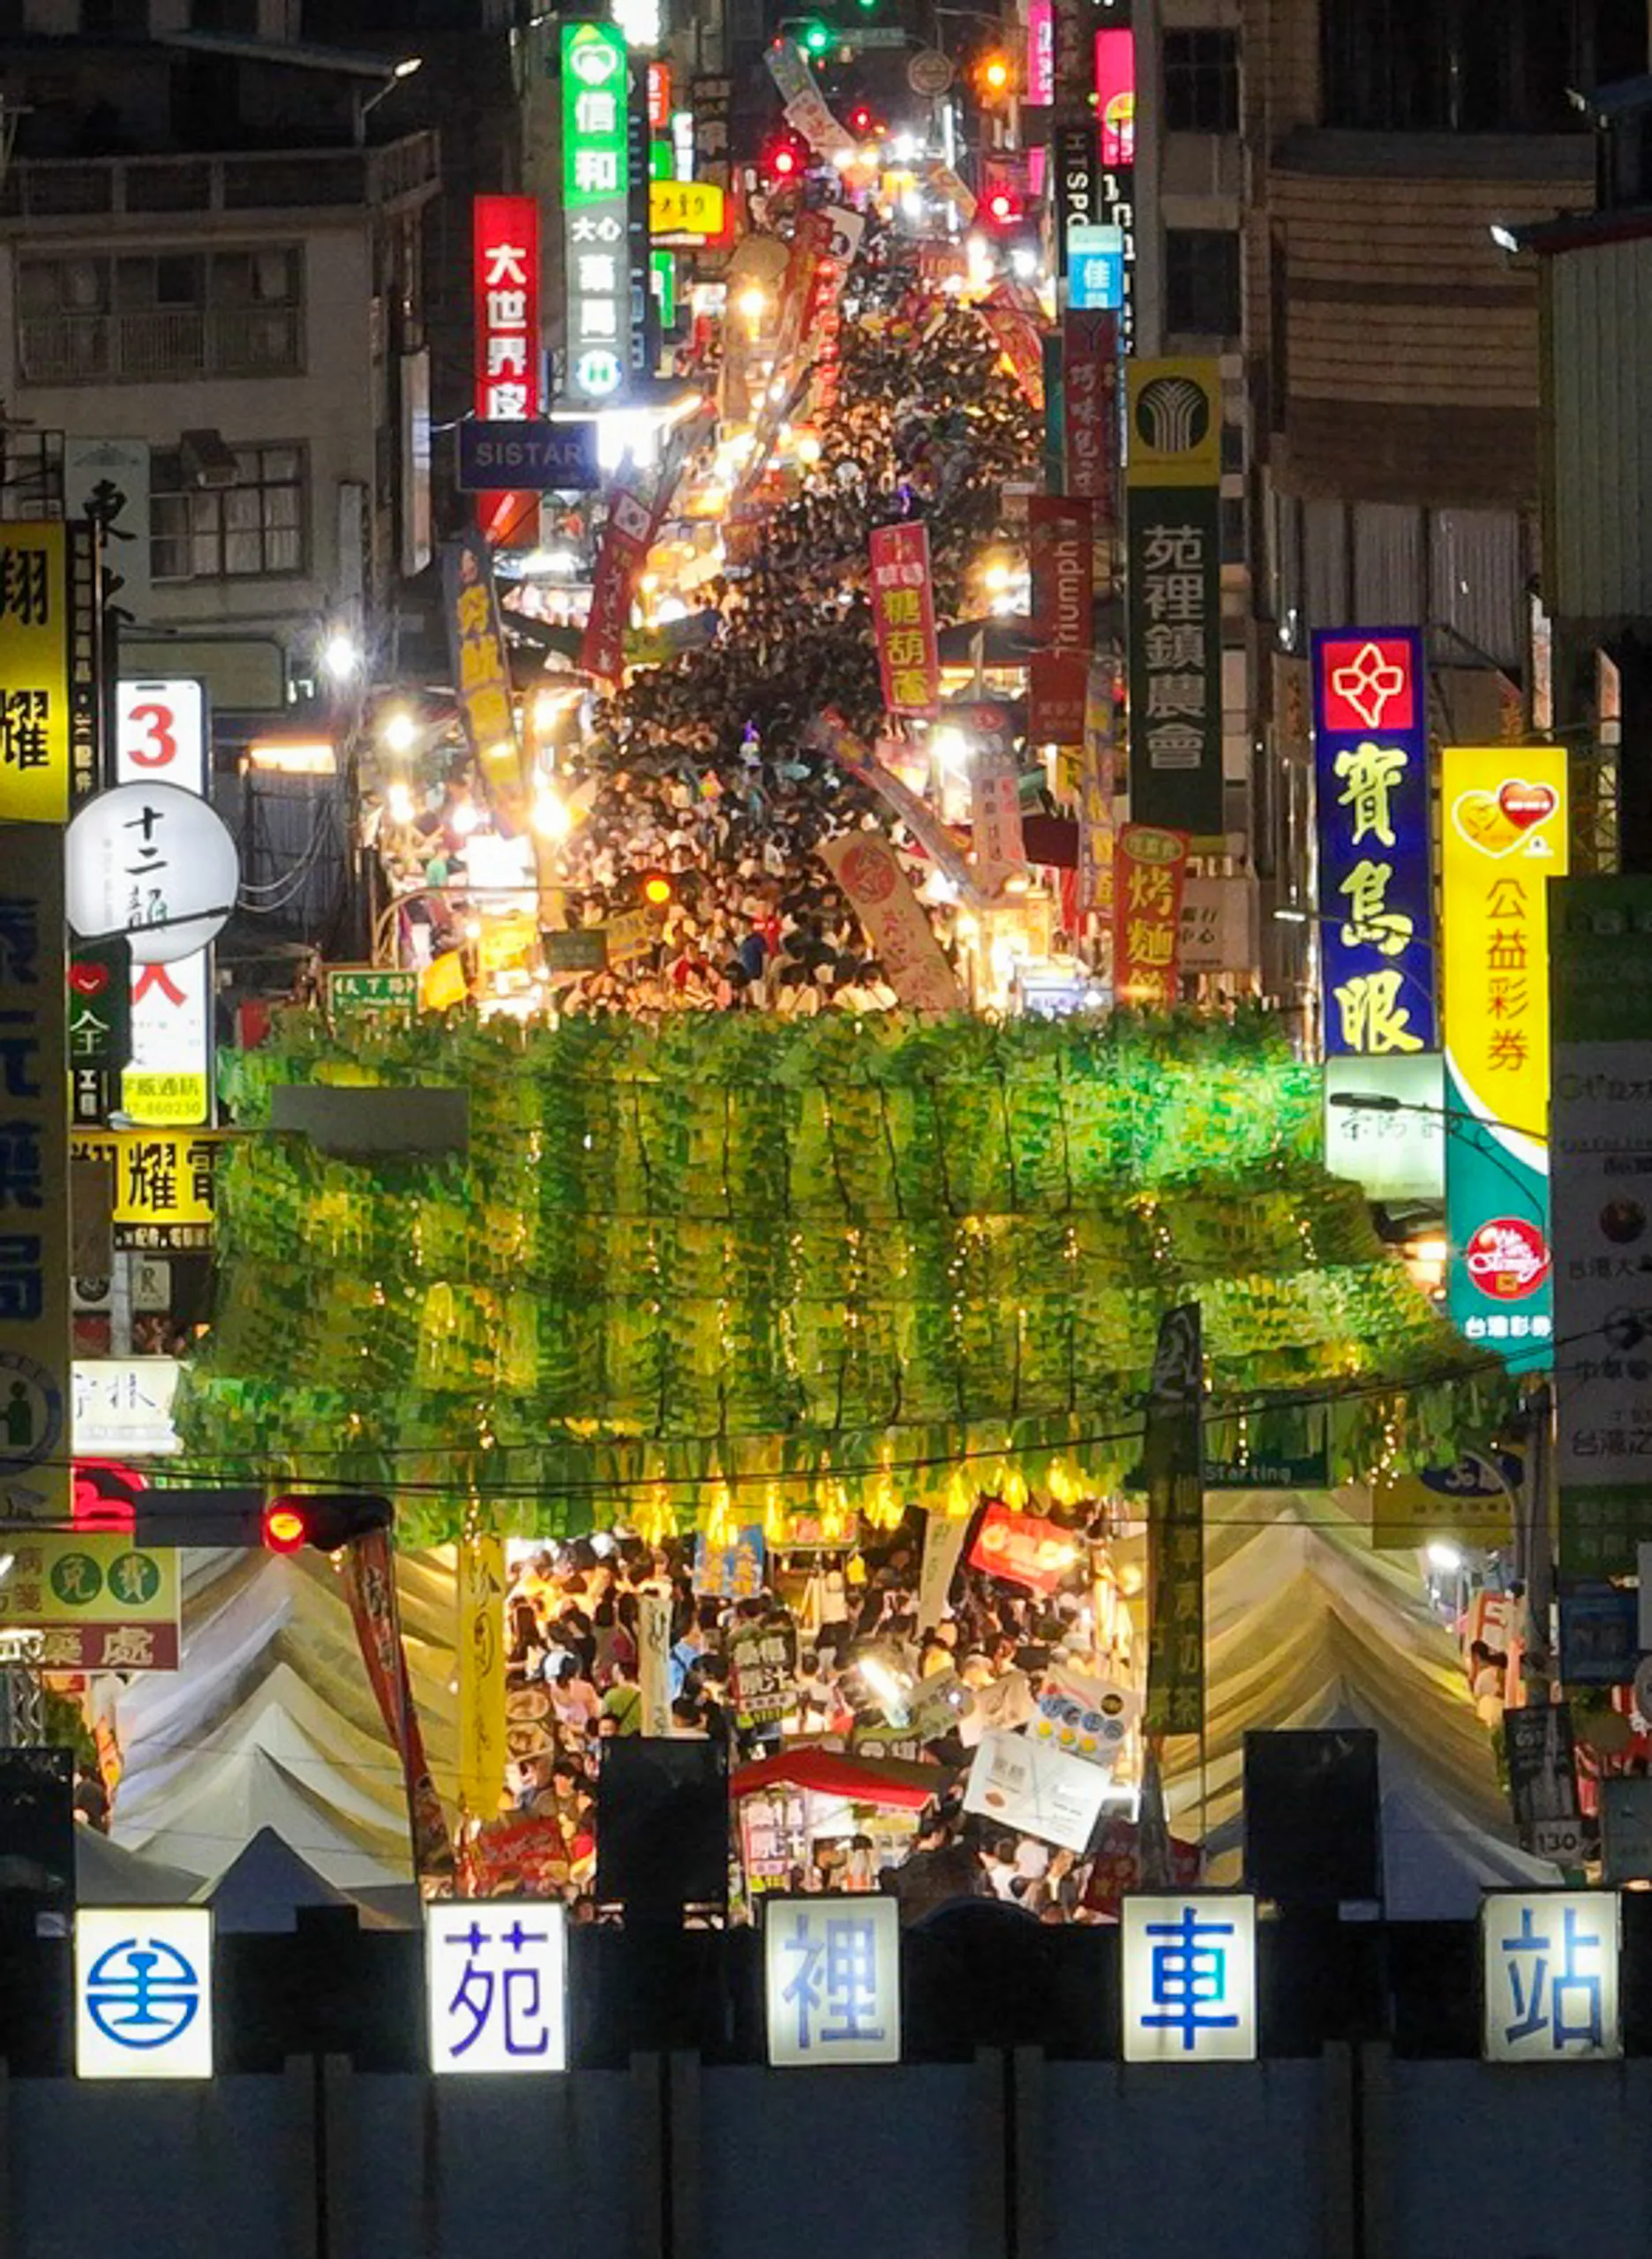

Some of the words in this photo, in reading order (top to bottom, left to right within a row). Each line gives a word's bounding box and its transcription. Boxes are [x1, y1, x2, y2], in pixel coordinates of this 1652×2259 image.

[1142, 524, 1206, 769] 苑裡鎮農會
[128, 703, 176, 769] 3
[1486, 878, 1529, 1071] 公益彩券
[445, 1920, 551, 2057] 苑
[784, 1912, 884, 2050] 裡
[1140, 1906, 1239, 2051] 車
[1501, 1907, 1603, 2050] 站
